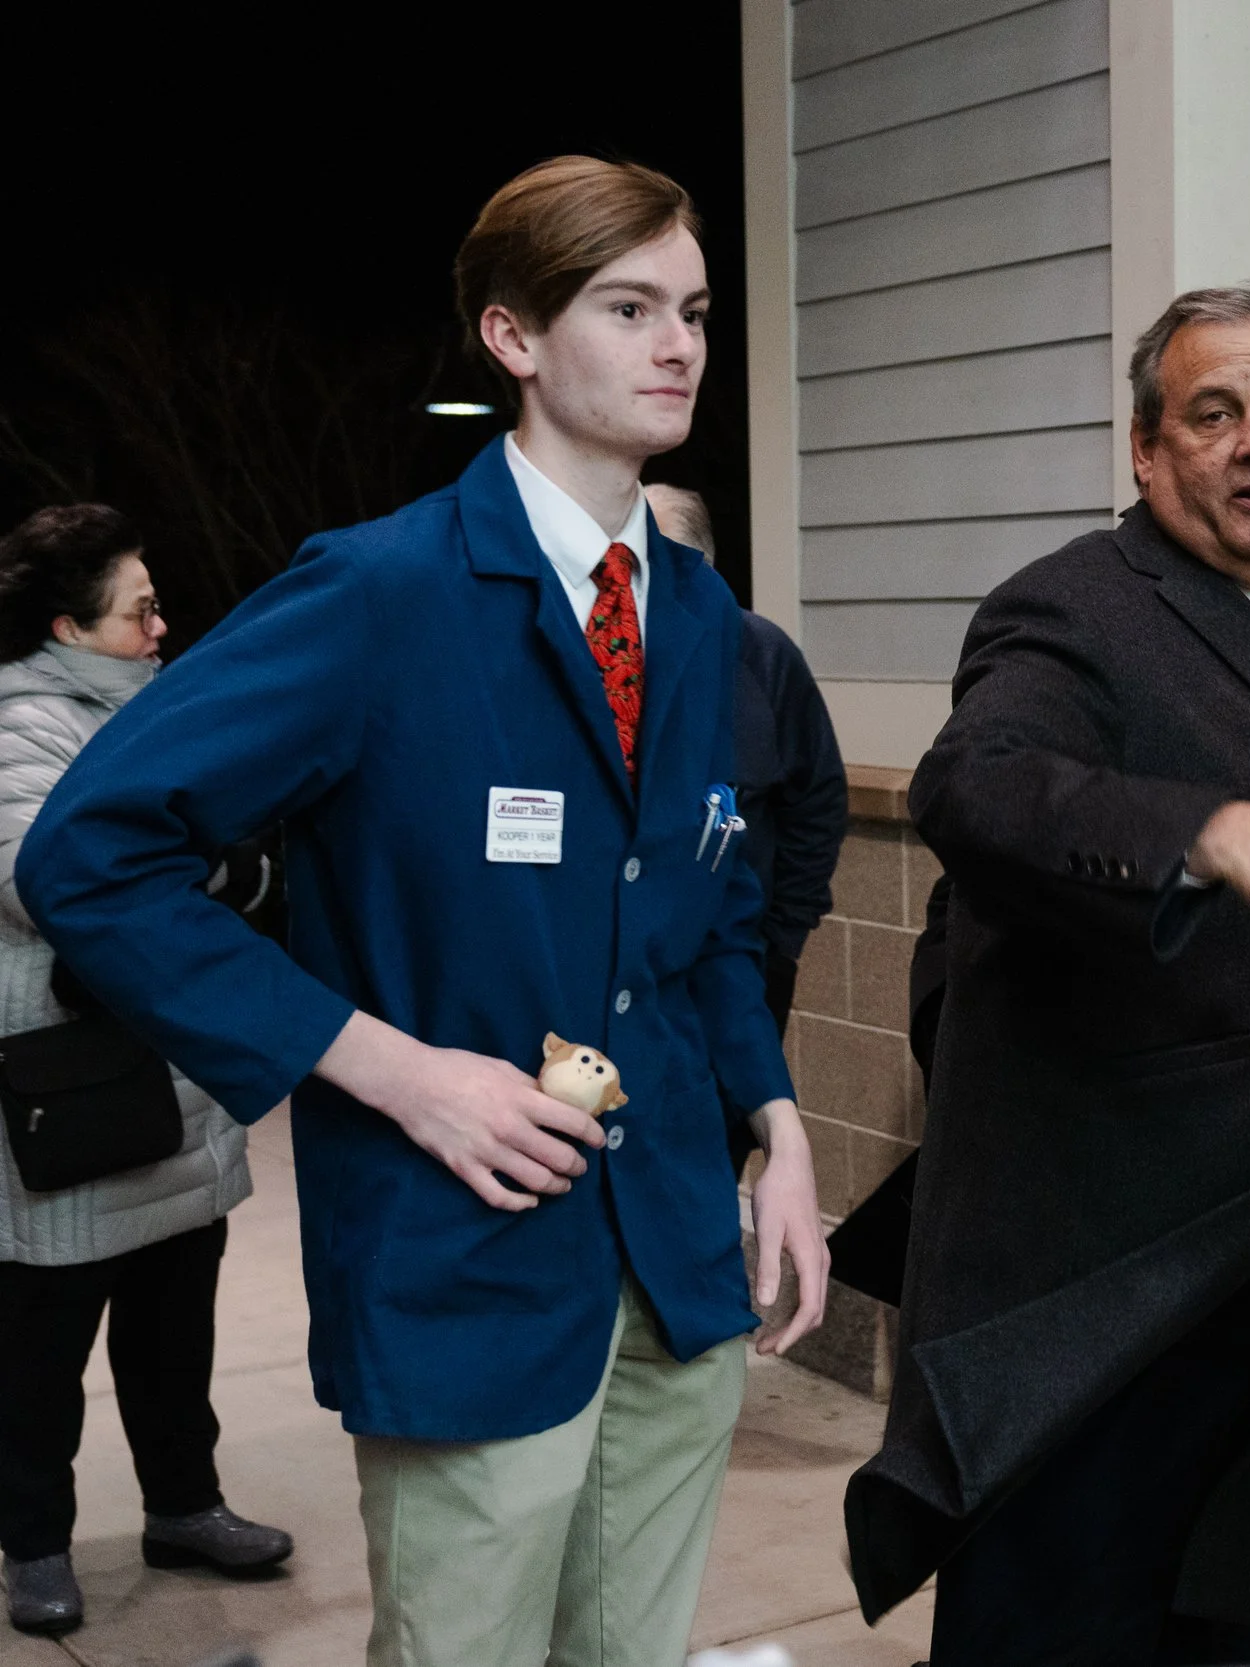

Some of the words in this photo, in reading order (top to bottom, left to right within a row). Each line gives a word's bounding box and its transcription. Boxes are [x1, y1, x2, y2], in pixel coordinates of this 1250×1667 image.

[497, 831, 528, 841] KOOPER
[536, 832, 556, 842] YEAR
[532, 849, 559, 860] Service
